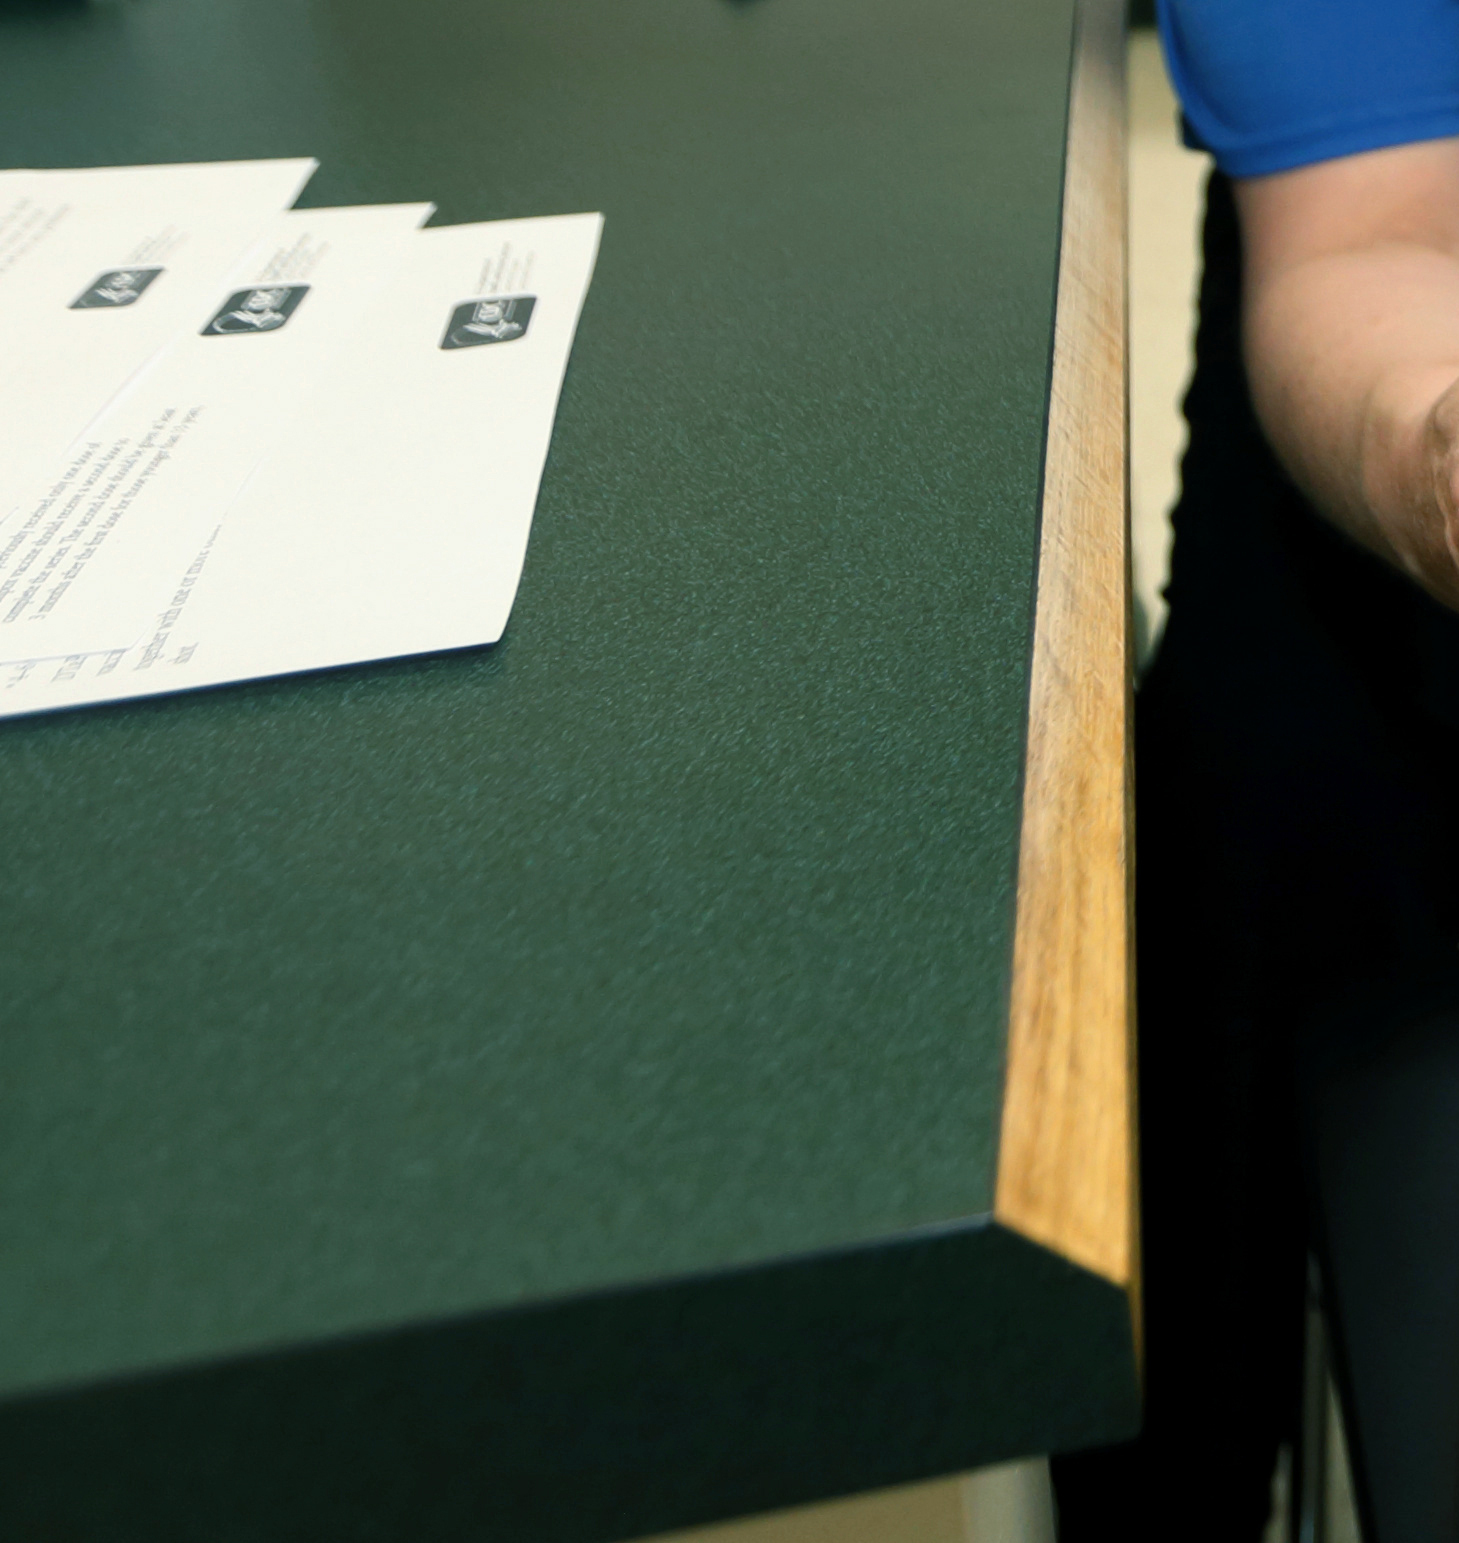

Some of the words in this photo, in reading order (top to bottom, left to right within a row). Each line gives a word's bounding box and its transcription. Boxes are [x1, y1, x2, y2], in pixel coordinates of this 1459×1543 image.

[2, 585, 41, 624] complete
[28, 570, 52, 584] the
[58, 528, 85, 544] The
[38, 580, 72, 613] months
[61, 561, 87, 580] after
[74, 546, 97, 560] the
[180, 575, 199, 587] or
[170, 587, 193, 607] one
[156, 606, 183, 632] with
[132, 630, 171, 672] together
